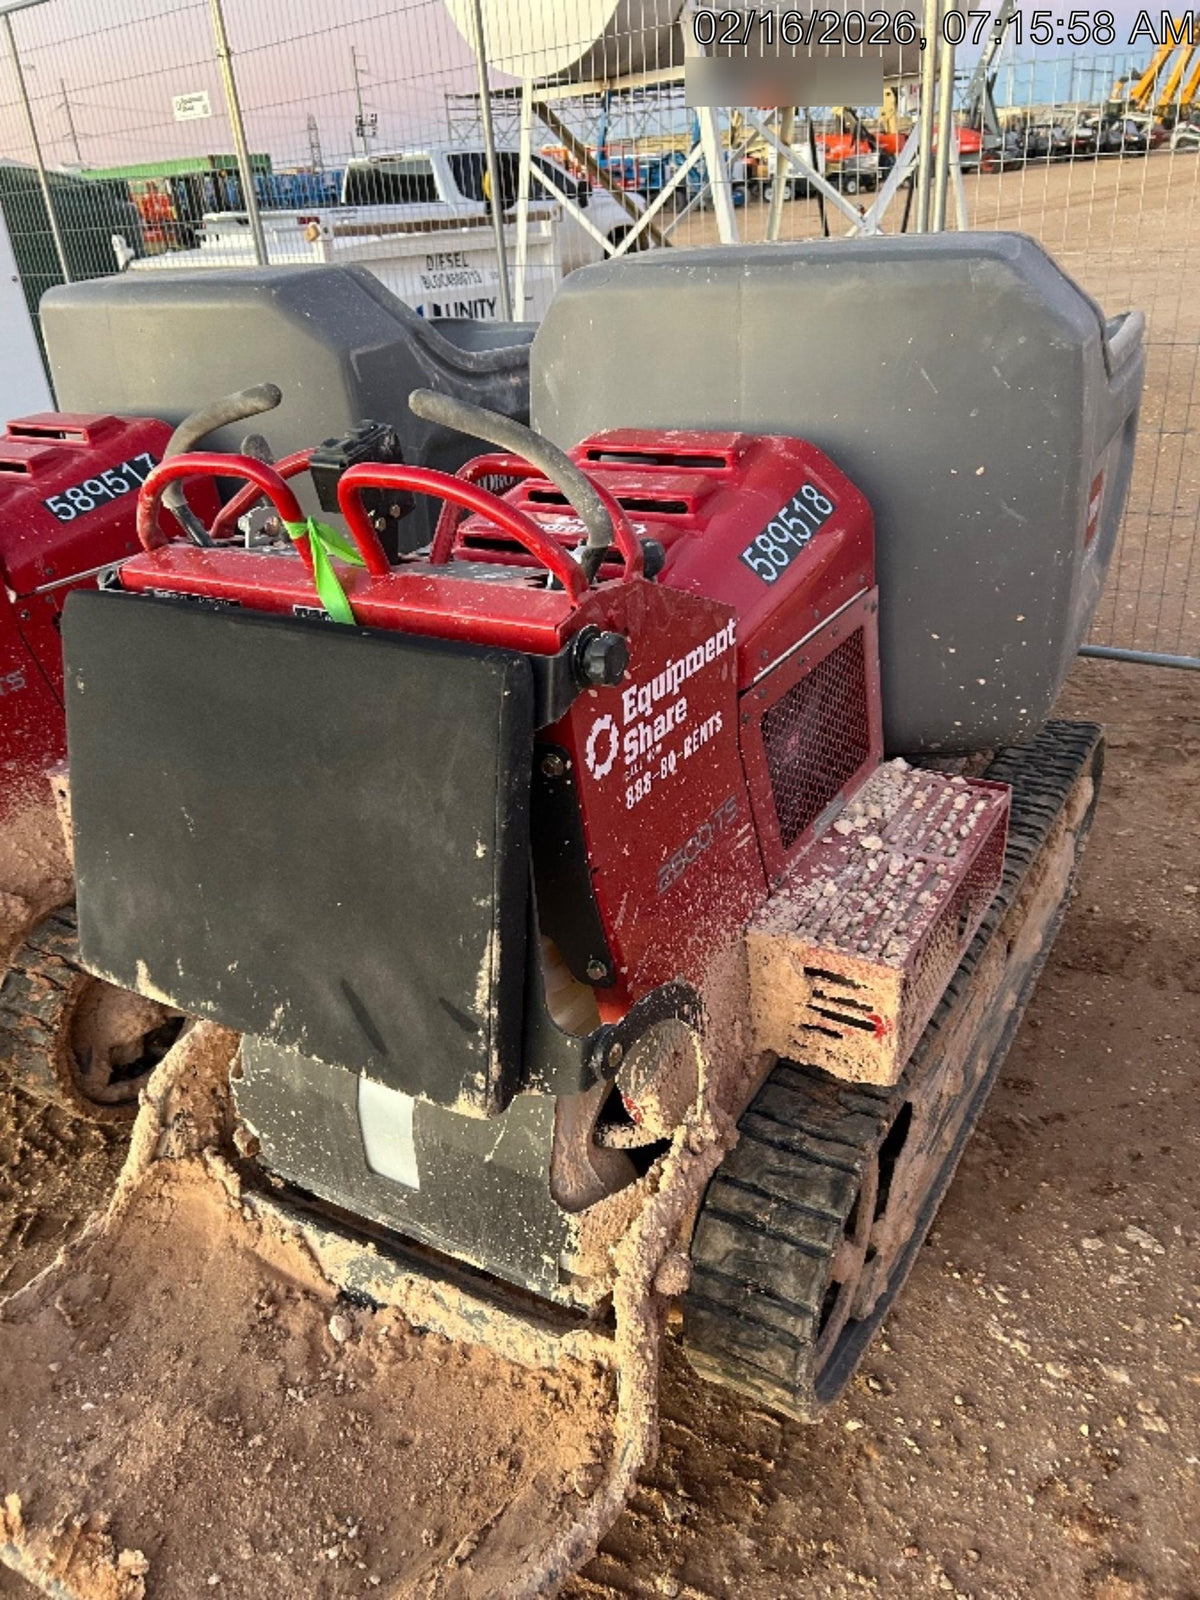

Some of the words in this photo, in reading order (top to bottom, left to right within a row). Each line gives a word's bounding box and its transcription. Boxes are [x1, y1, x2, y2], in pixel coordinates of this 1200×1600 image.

[426, 251, 469, 271] DIESEL
[445, 296, 497, 319] UNITY
[45, 452, 156, 520] 589517
[742, 484, 833, 581] 589518
[621, 618, 737, 726] Equipment
[623, 697, 688, 765] Share
